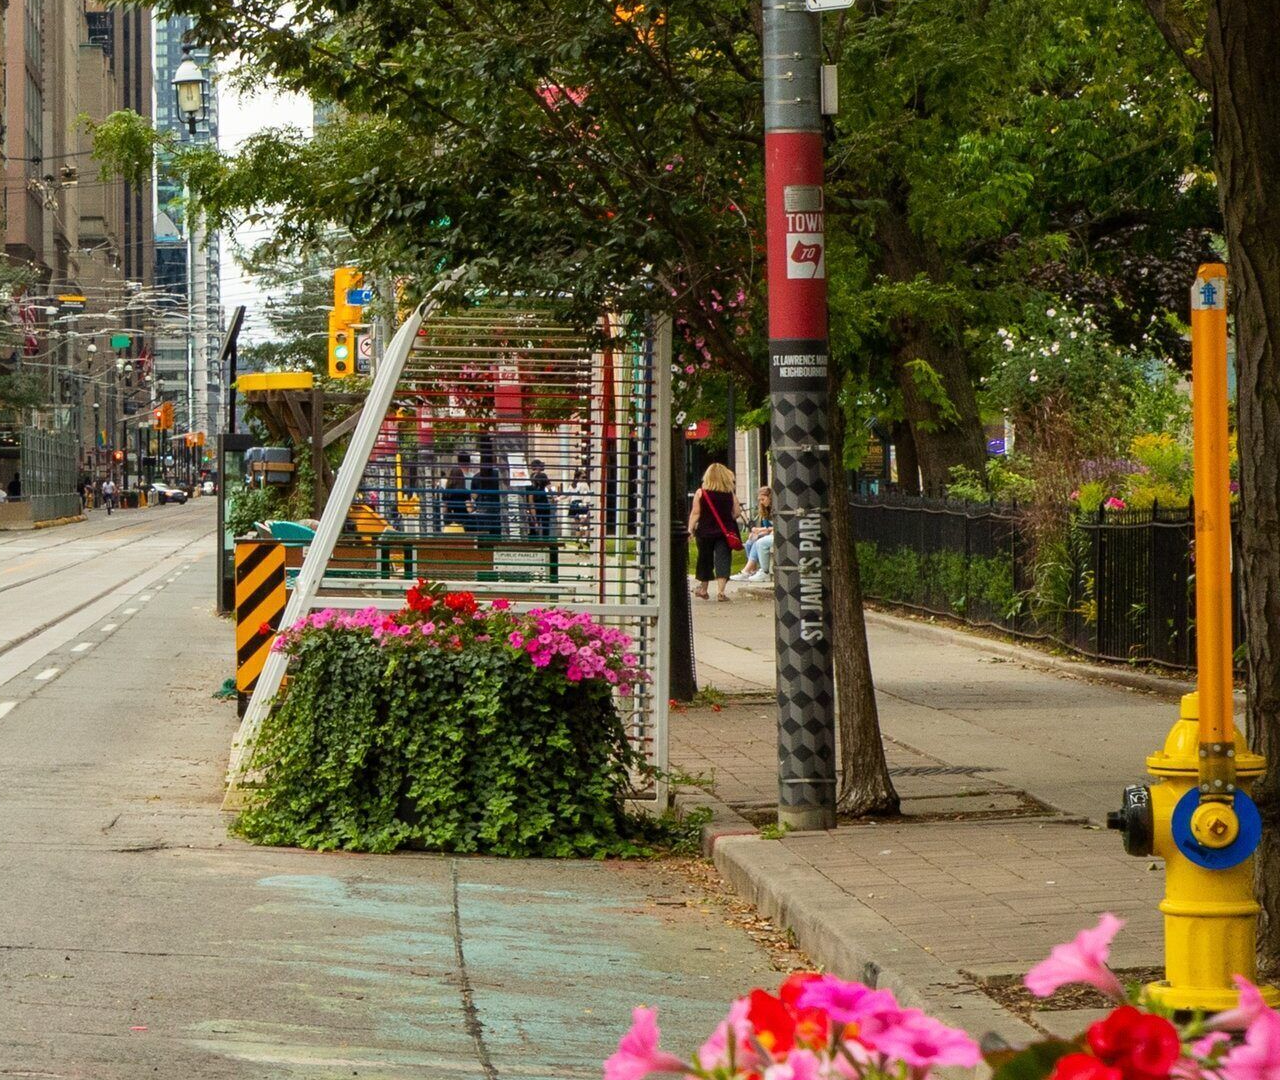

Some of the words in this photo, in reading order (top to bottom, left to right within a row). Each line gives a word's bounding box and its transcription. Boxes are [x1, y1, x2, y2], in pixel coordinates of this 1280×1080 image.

[800, 247, 816, 260] TO
[780, 354, 816, 366] LAWRENCE
[799, 557, 824, 612] JAMES
[800, 617, 824, 641] ST.
